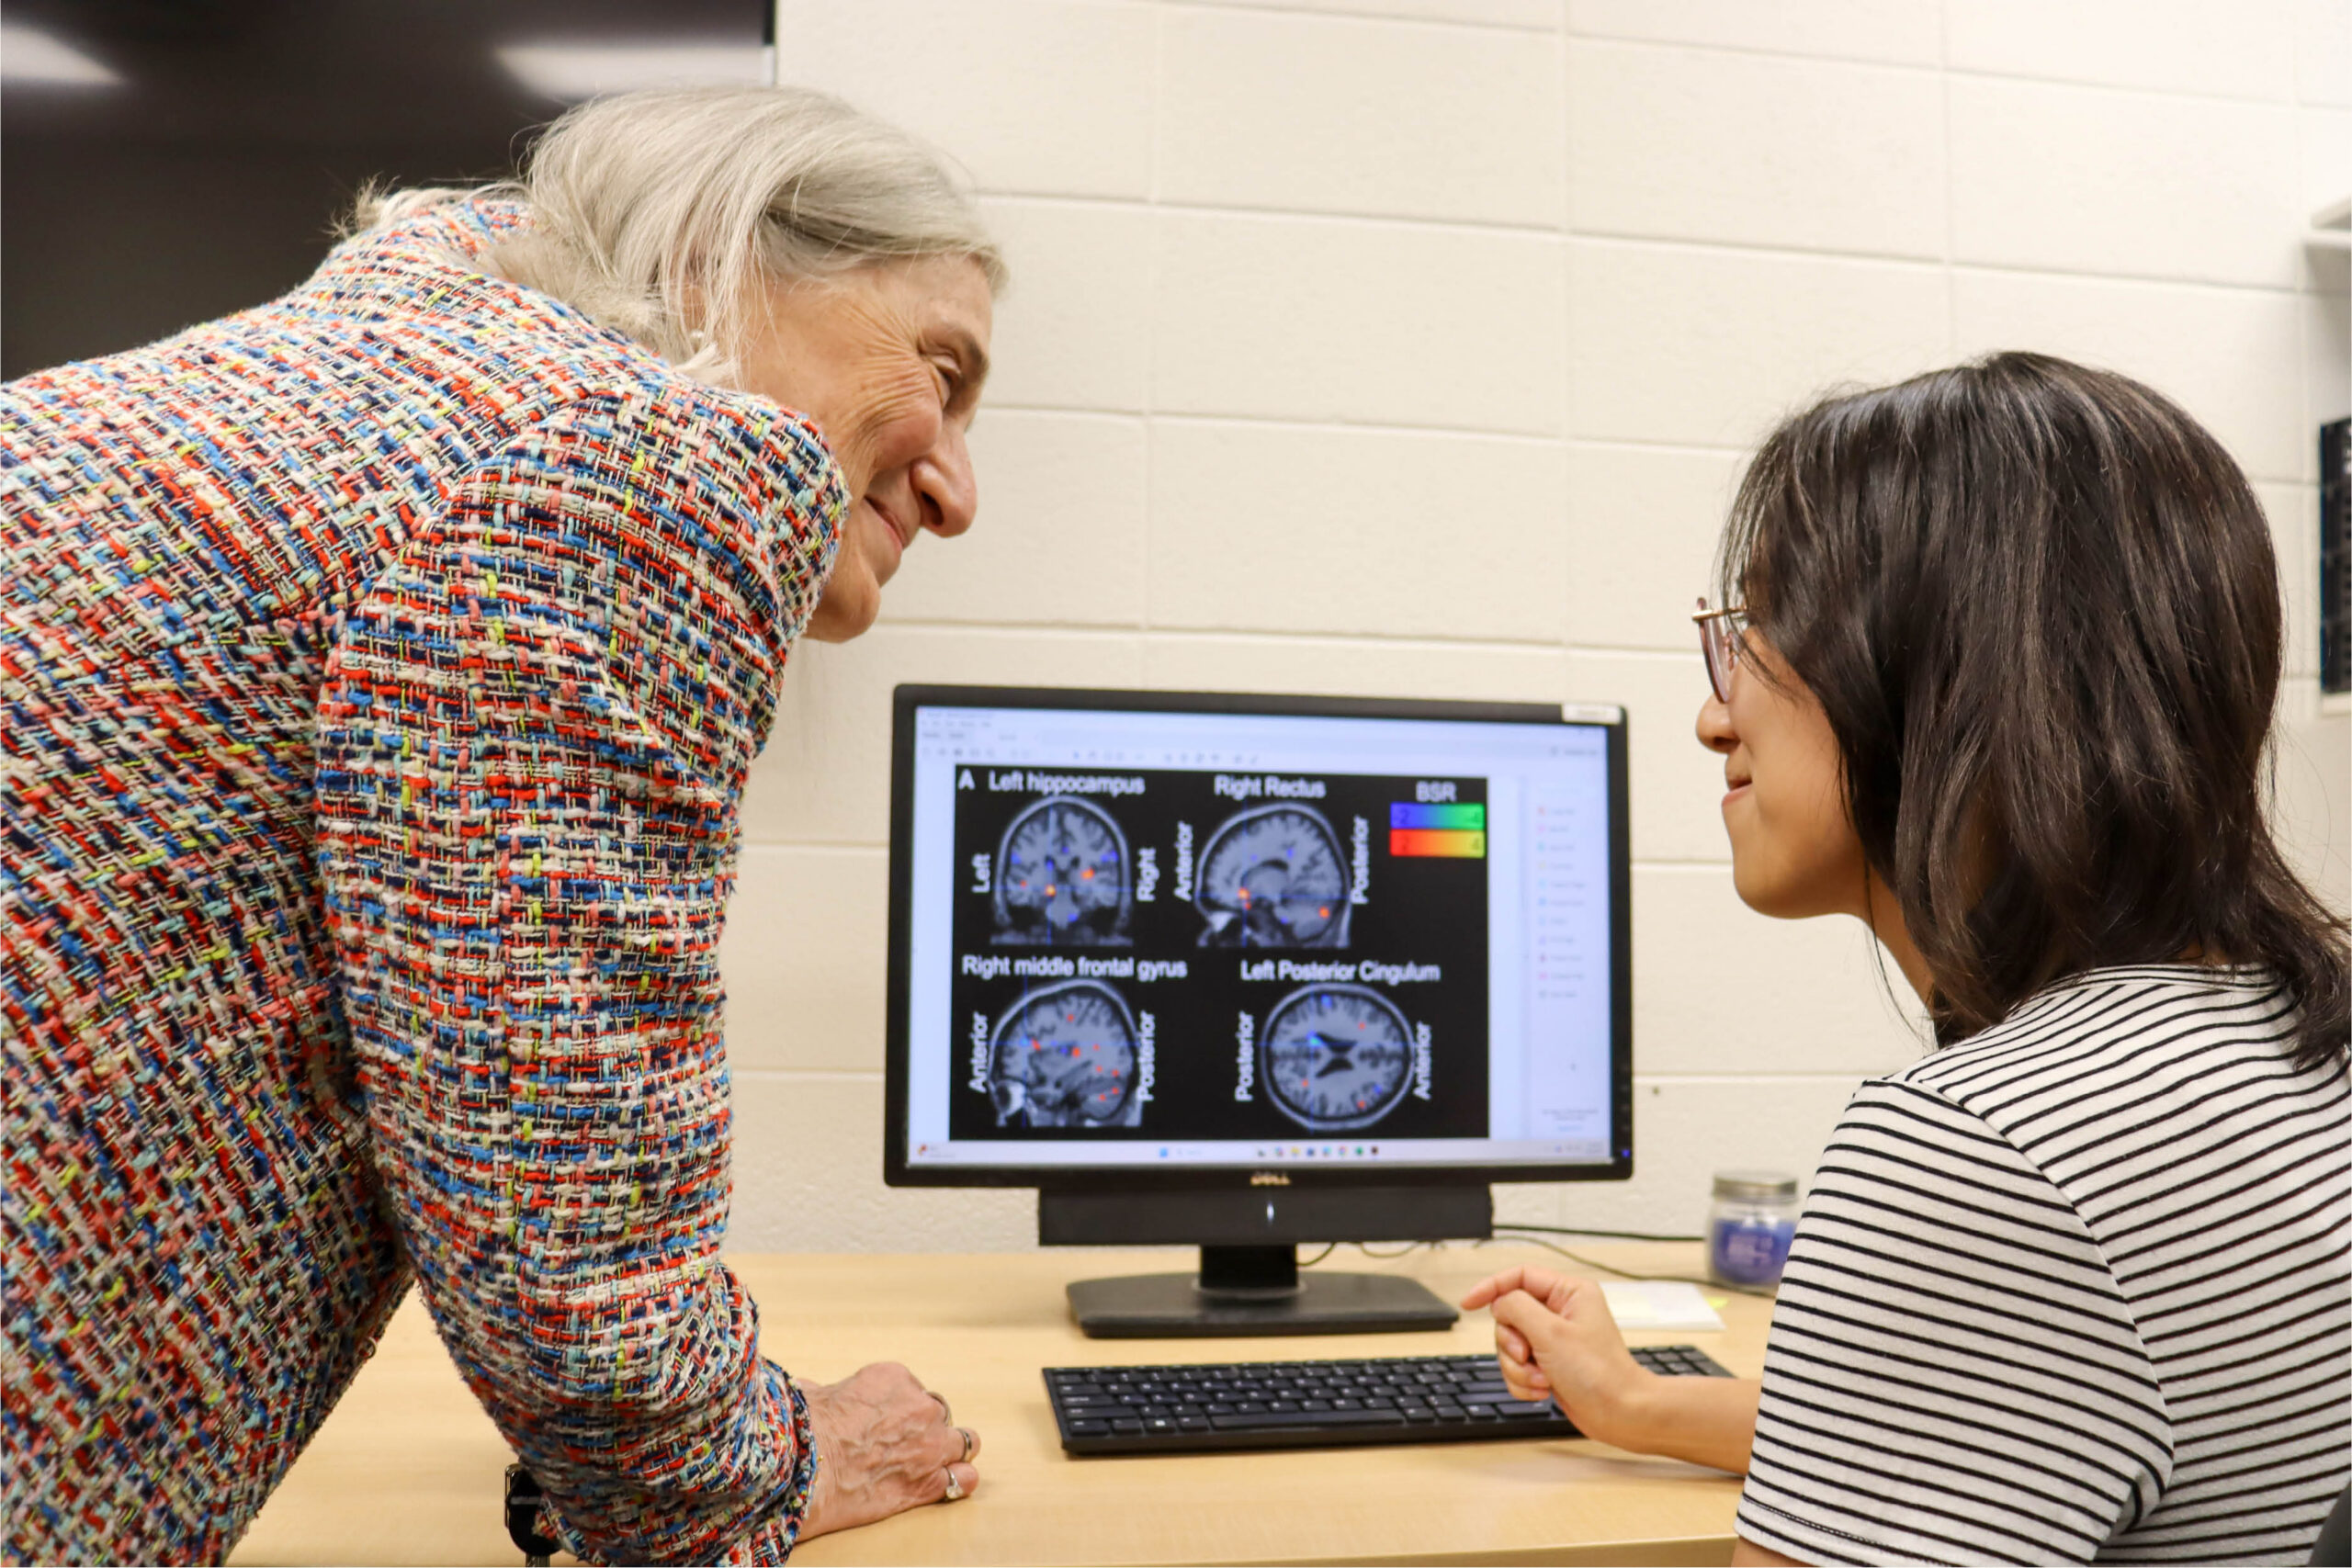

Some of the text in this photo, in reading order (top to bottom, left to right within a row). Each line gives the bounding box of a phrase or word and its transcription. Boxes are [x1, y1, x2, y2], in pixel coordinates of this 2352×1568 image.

[958, 768, 976, 790] A
[989, 770, 1146, 797] Left hippocampus
[1215, 774, 1327, 801] Right Rectus
[1416, 781, 1456, 802] BSR
[972, 853, 991, 893] Left
[1137, 848, 1159, 901] Right
[1174, 821, 1193, 901] Anterior
[1351, 815, 1370, 905] Posterior
[962, 954, 1188, 982] Right middle frontal gyrus
[1240, 959, 1442, 986] Left Posterior Cingulum
[969, 1011, 988, 1093] Anterior
[1136, 1010, 1155, 1101] Posterior
[1235, 1011, 1253, 1101] Posterior
[1413, 1021, 1432, 1100] Anterior
